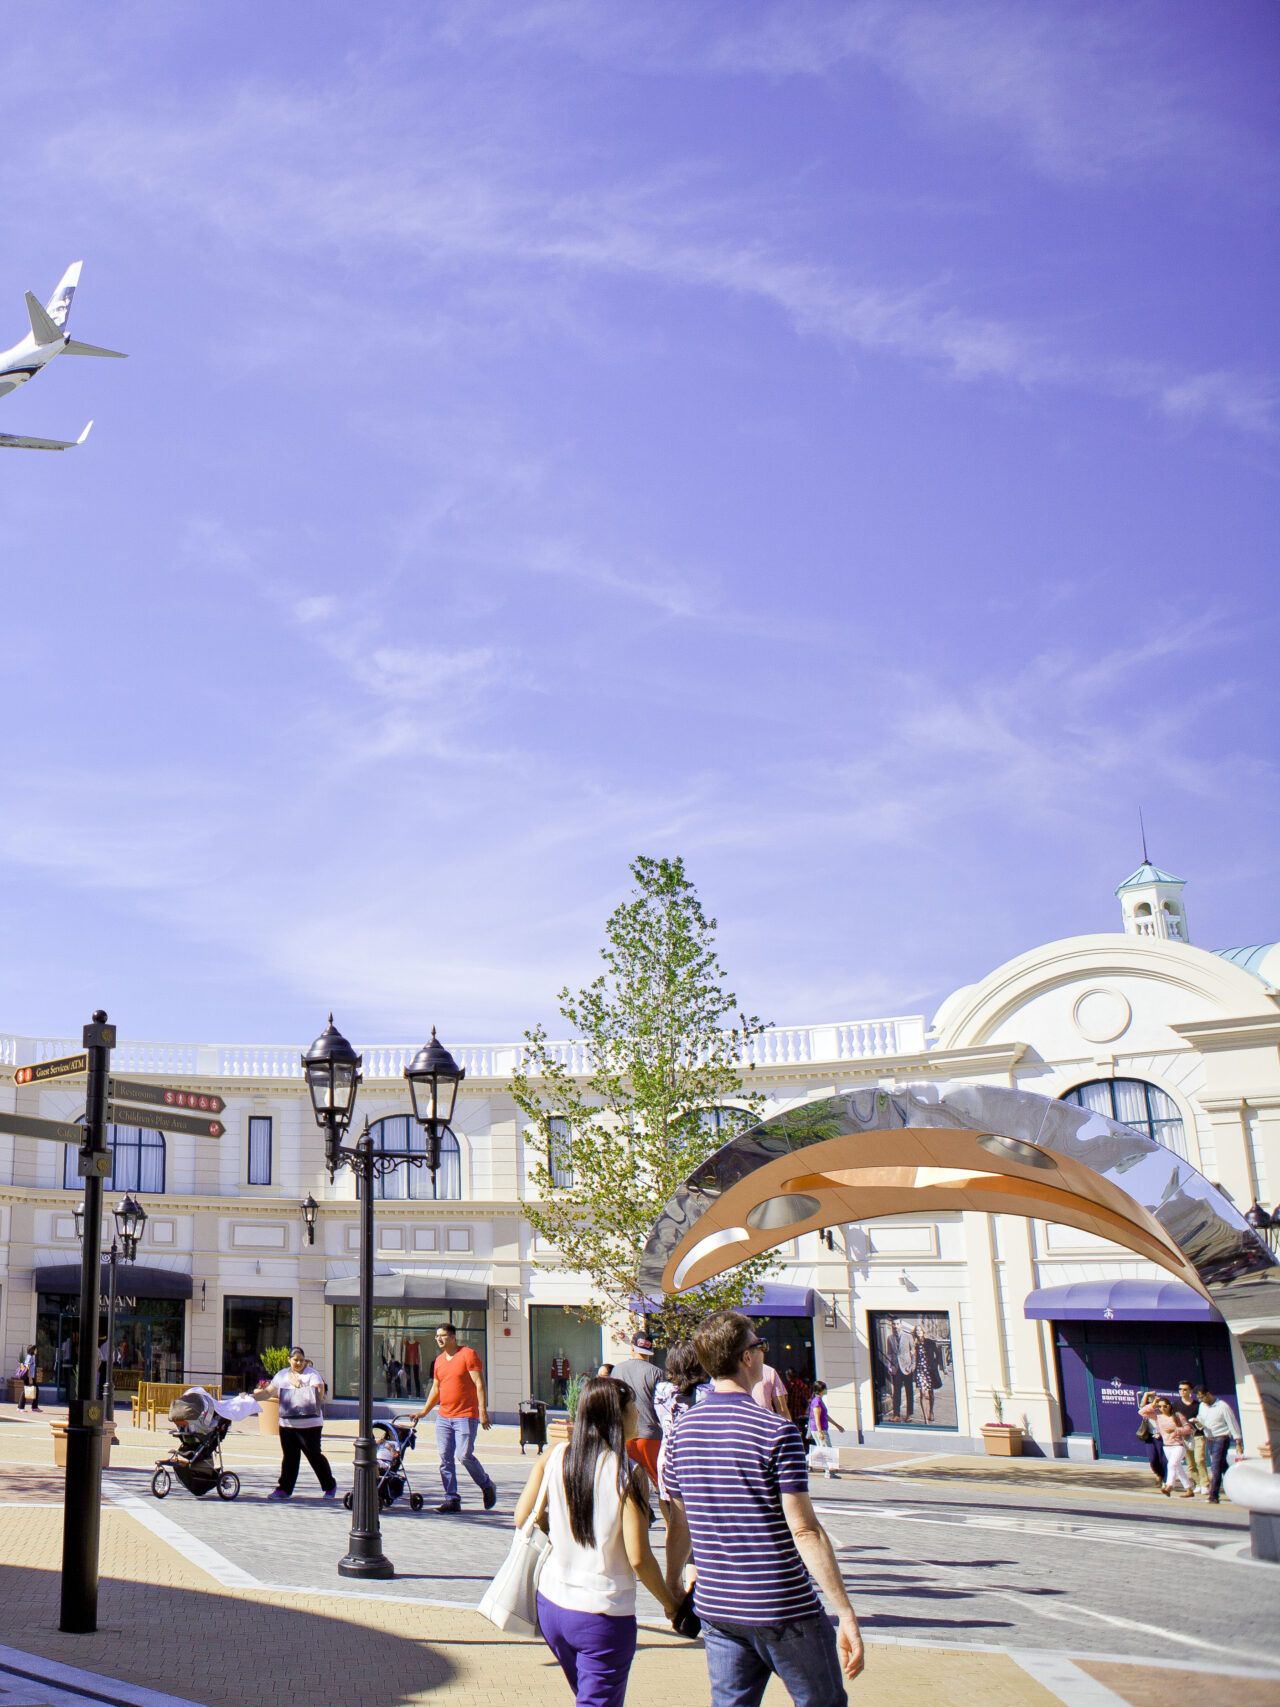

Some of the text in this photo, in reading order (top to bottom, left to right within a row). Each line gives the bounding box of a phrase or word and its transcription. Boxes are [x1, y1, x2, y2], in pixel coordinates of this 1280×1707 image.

[36, 1058, 84, 1077] Guest Services/ATM
[120, 1085, 157, 1100] Restrooms
[118, 1109, 188, 1129] Children's Play Area
[1101, 1388, 1134, 1396] BROOKS
